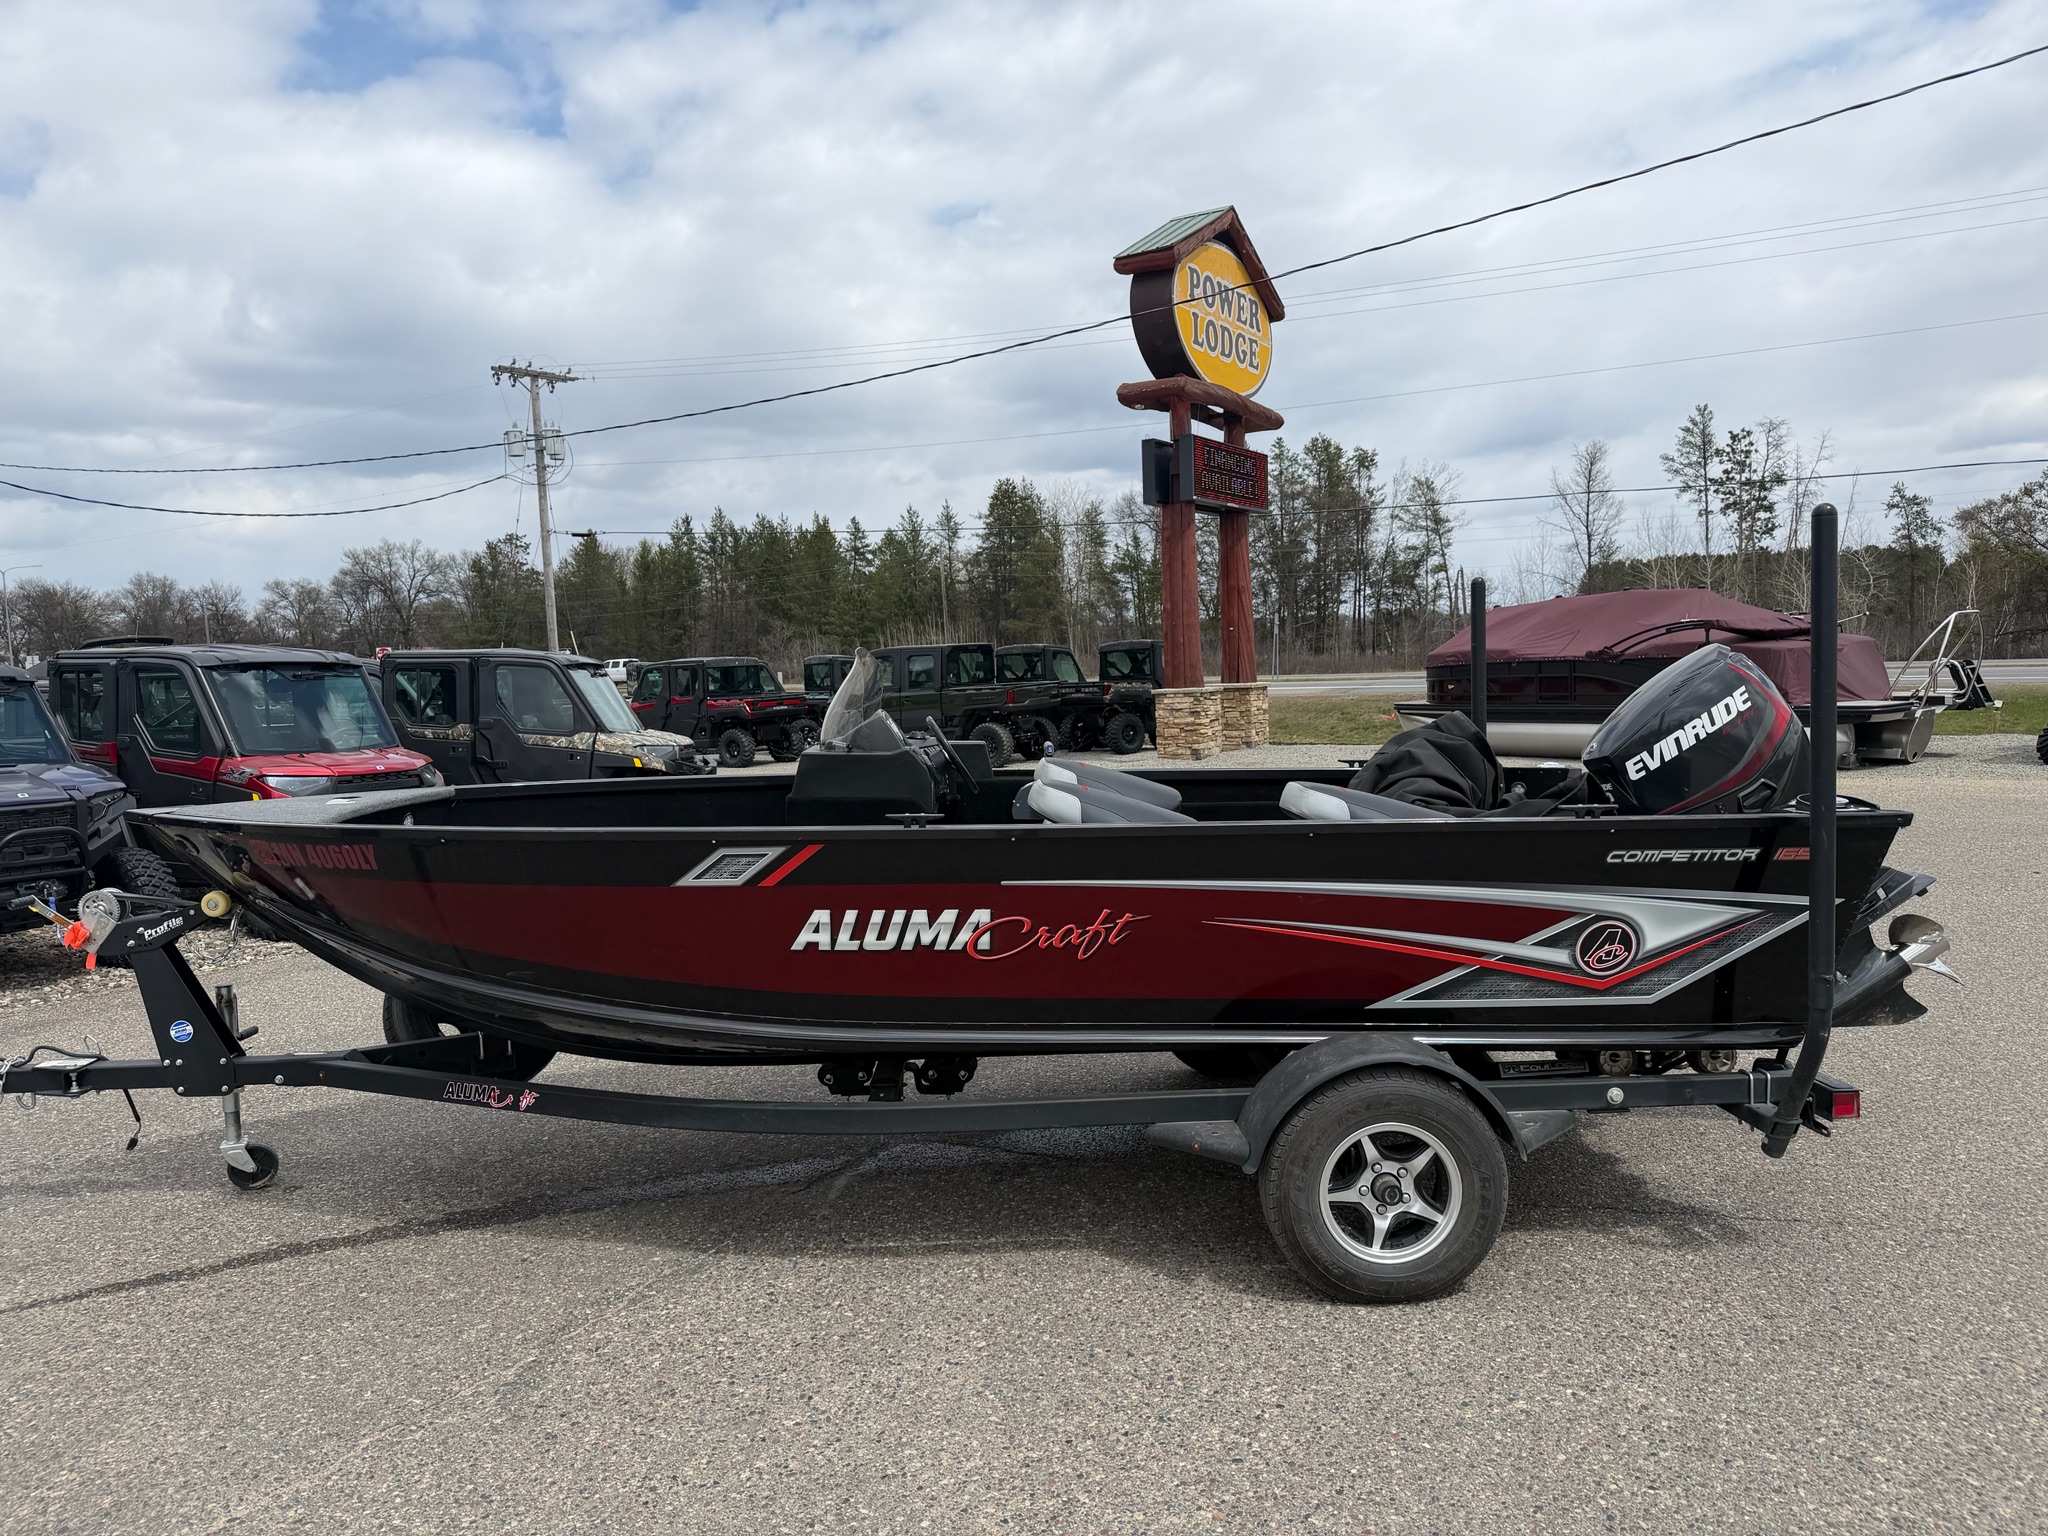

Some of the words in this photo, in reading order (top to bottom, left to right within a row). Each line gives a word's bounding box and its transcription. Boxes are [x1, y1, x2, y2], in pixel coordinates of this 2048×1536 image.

[1187, 265, 1261, 333] POWER
[1191, 311, 1260, 371] LODGE
[1204, 446, 1256, 476] FINANCING
[1625, 684, 1753, 781] EVINRUDE
[305, 843, 379, 870] 4060LY
[1607, 847, 1762, 863] COMPETITOR
[144, 916, 184, 941] Profile
